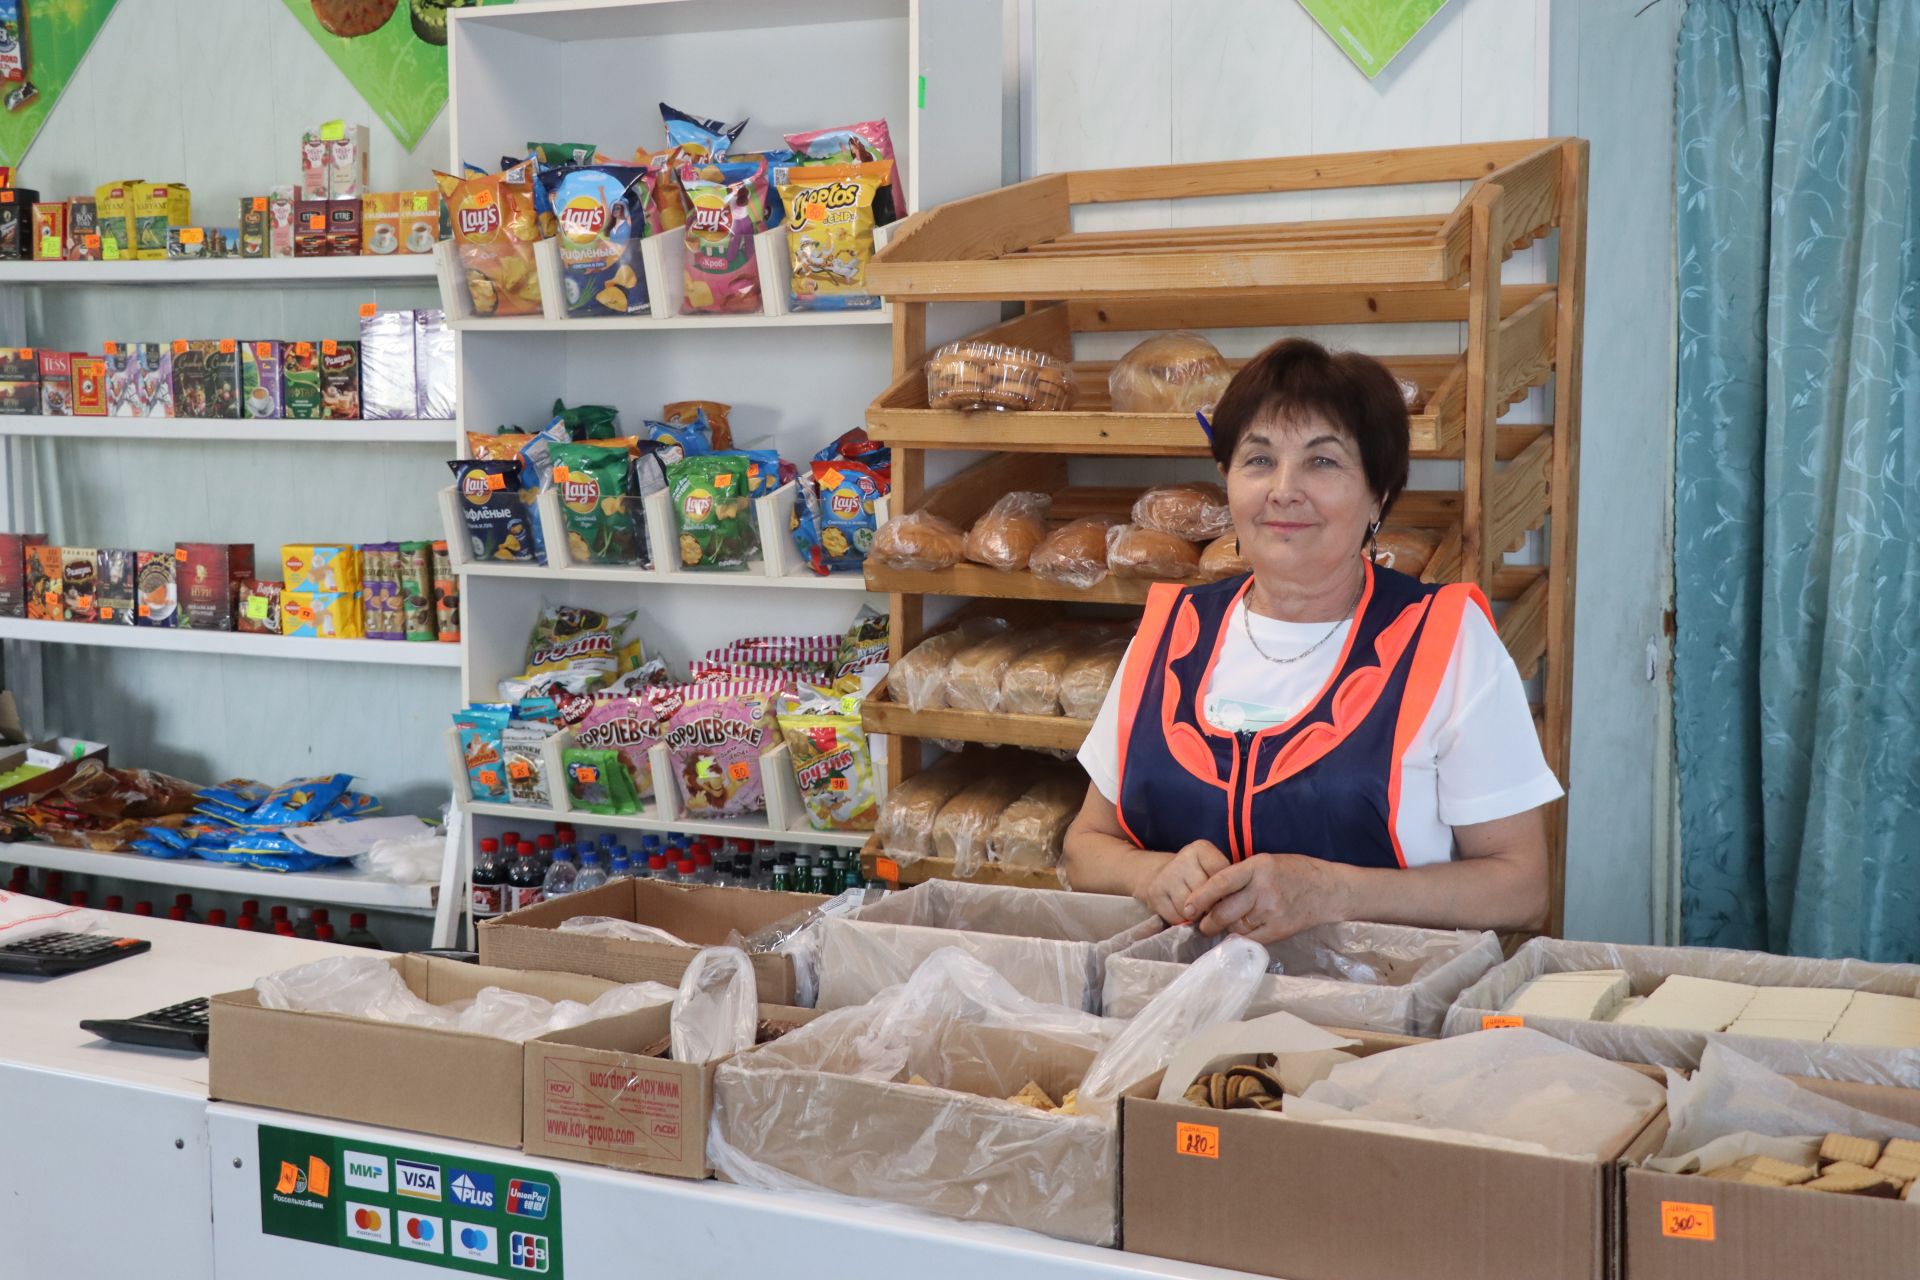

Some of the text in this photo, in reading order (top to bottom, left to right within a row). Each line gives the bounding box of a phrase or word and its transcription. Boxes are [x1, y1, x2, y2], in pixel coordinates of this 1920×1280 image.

[461, 205, 498, 233] Lay's
[45, 357, 67, 371] TESS
[565, 480, 597, 503] Lay's
[833, 495, 860, 512] Lay's
[533, 634, 613, 665] РУЗИК
[665, 717, 763, 752] КОРОЛЕВСКИЕ
[800, 751, 854, 788] РУЗИК
[550, 1083, 571, 1094] KDV
[547, 1118, 635, 1148] www.kdv-group.com
[350, 1163, 383, 1179] МИР
[401, 1170, 436, 1190] VISA
[273, 1193, 324, 1210] РоссельхозБанк
[462, 1188, 494, 1207] PLUS
[510, 1187, 547, 1204] UnionPay
[513, 1245, 546, 1261] JCB
